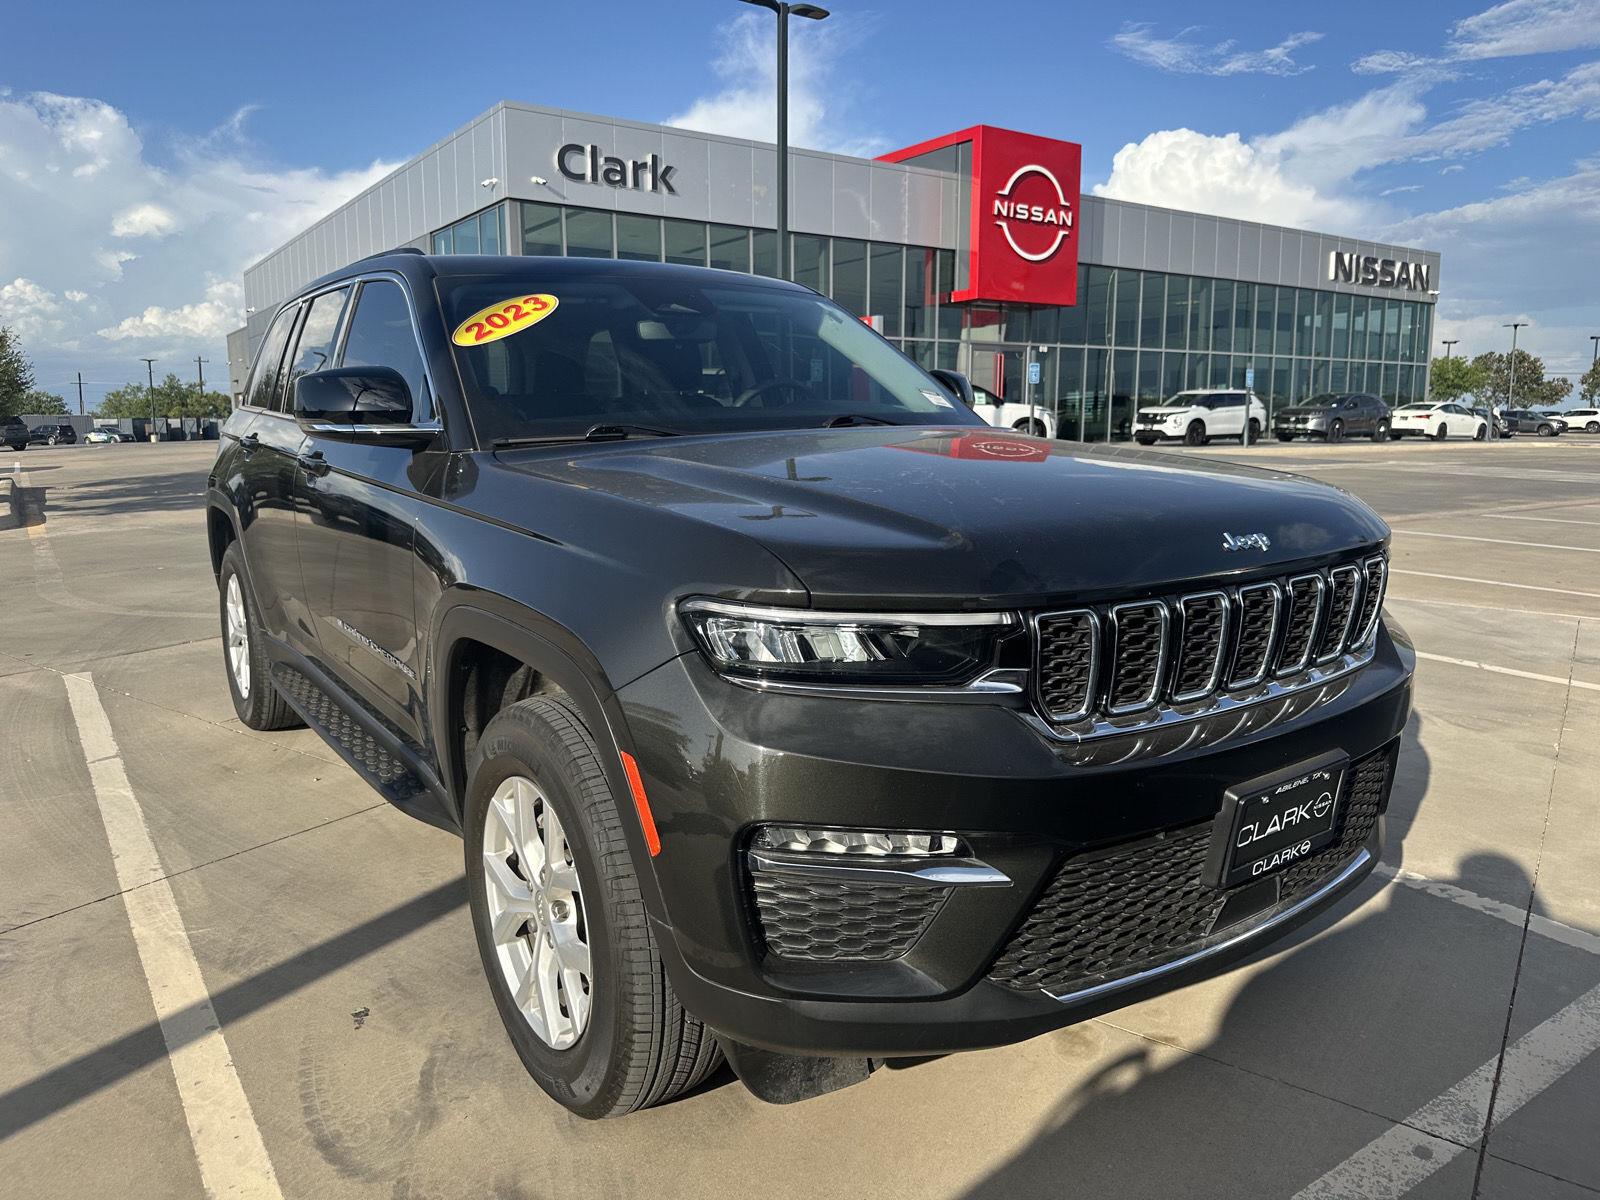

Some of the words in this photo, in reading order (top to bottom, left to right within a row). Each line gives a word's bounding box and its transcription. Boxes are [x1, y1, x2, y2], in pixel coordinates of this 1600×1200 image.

[556, 143, 677, 193] Clark
[992, 199, 1073, 227] NISSAN
[1328, 250, 1431, 292] NISSAN
[464, 296, 549, 342] 2023
[1222, 532, 1271, 552] Jeep
[1237, 800, 1314, 847] CLARK
[1252, 844, 1301, 875] CLARK
